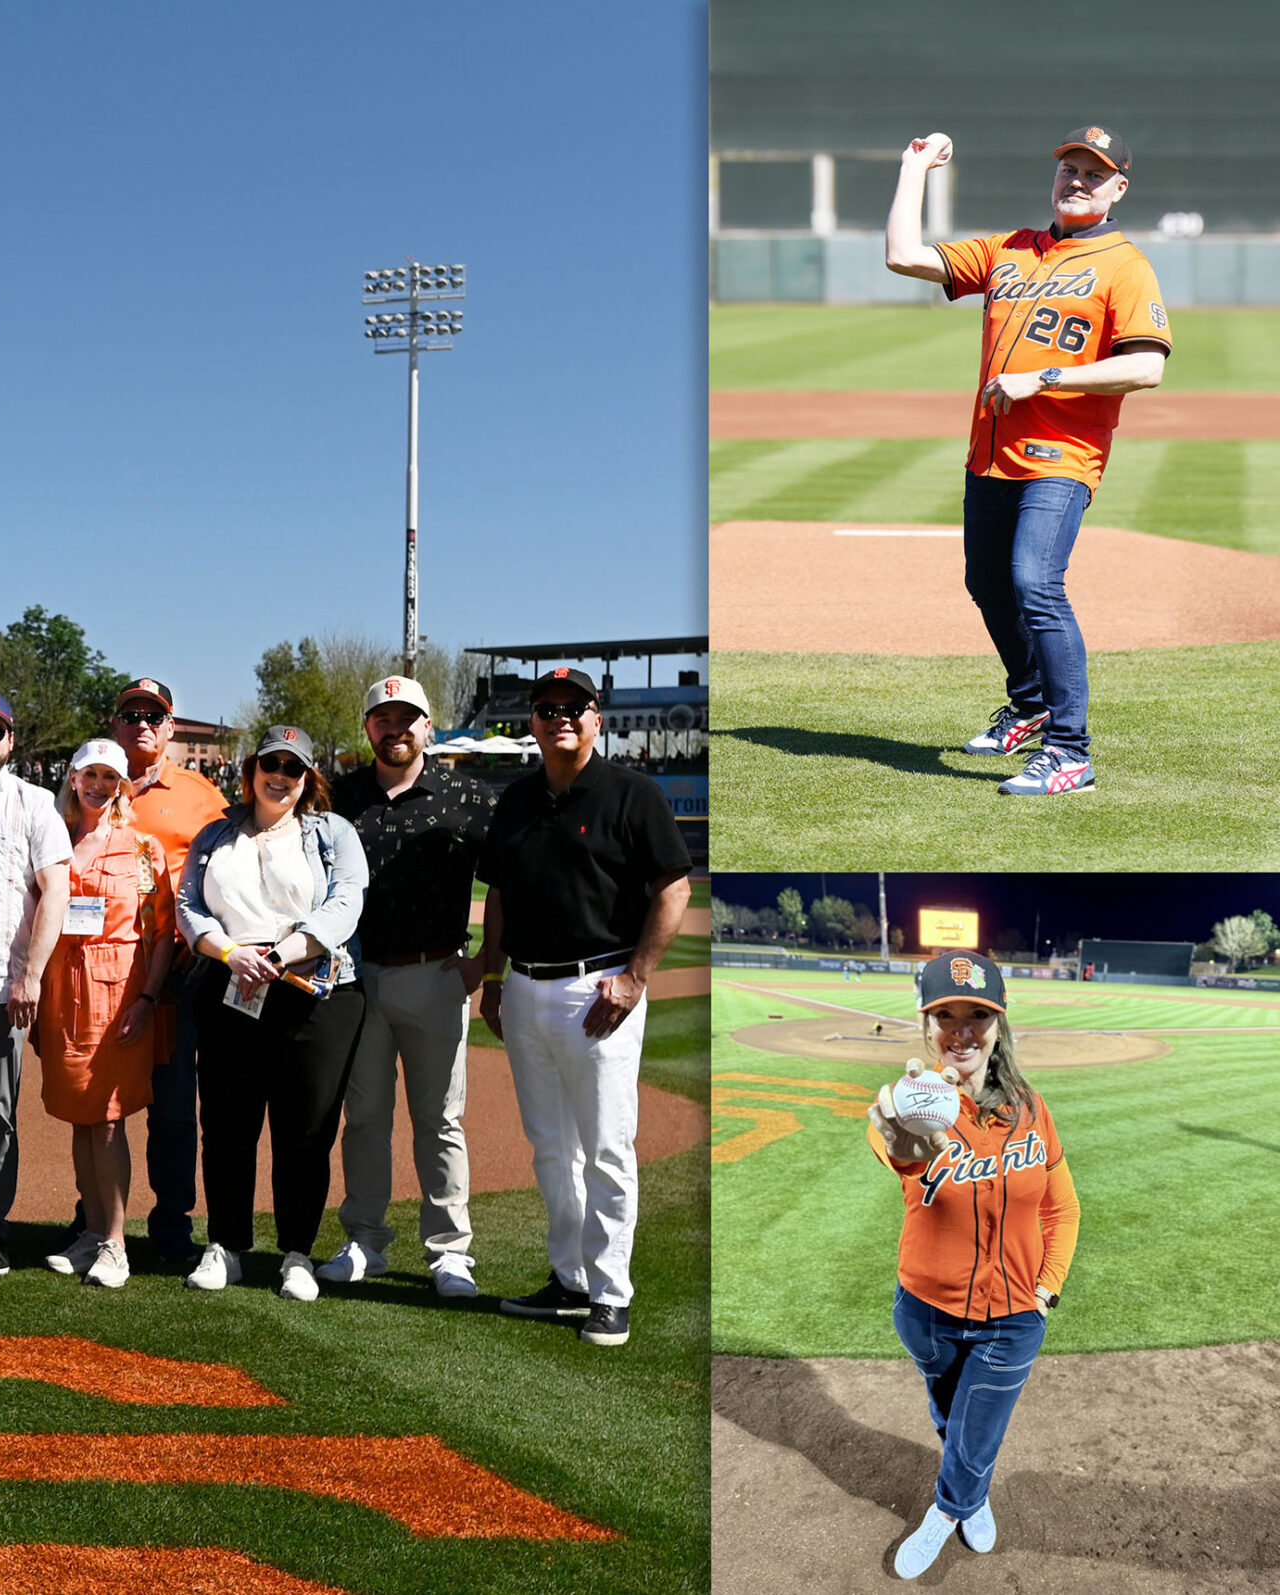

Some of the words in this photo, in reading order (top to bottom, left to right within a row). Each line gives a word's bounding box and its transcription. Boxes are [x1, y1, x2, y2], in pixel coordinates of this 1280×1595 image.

[984, 262, 1099, 312] Giants
[1150, 302, 1166, 329] SF
[1024, 306, 1092, 354] 26
[385, 679, 401, 697] SF
[609, 714, 656, 729] arro
[950, 957, 973, 985] SF
[920, 1131, 1047, 1206] Giants
